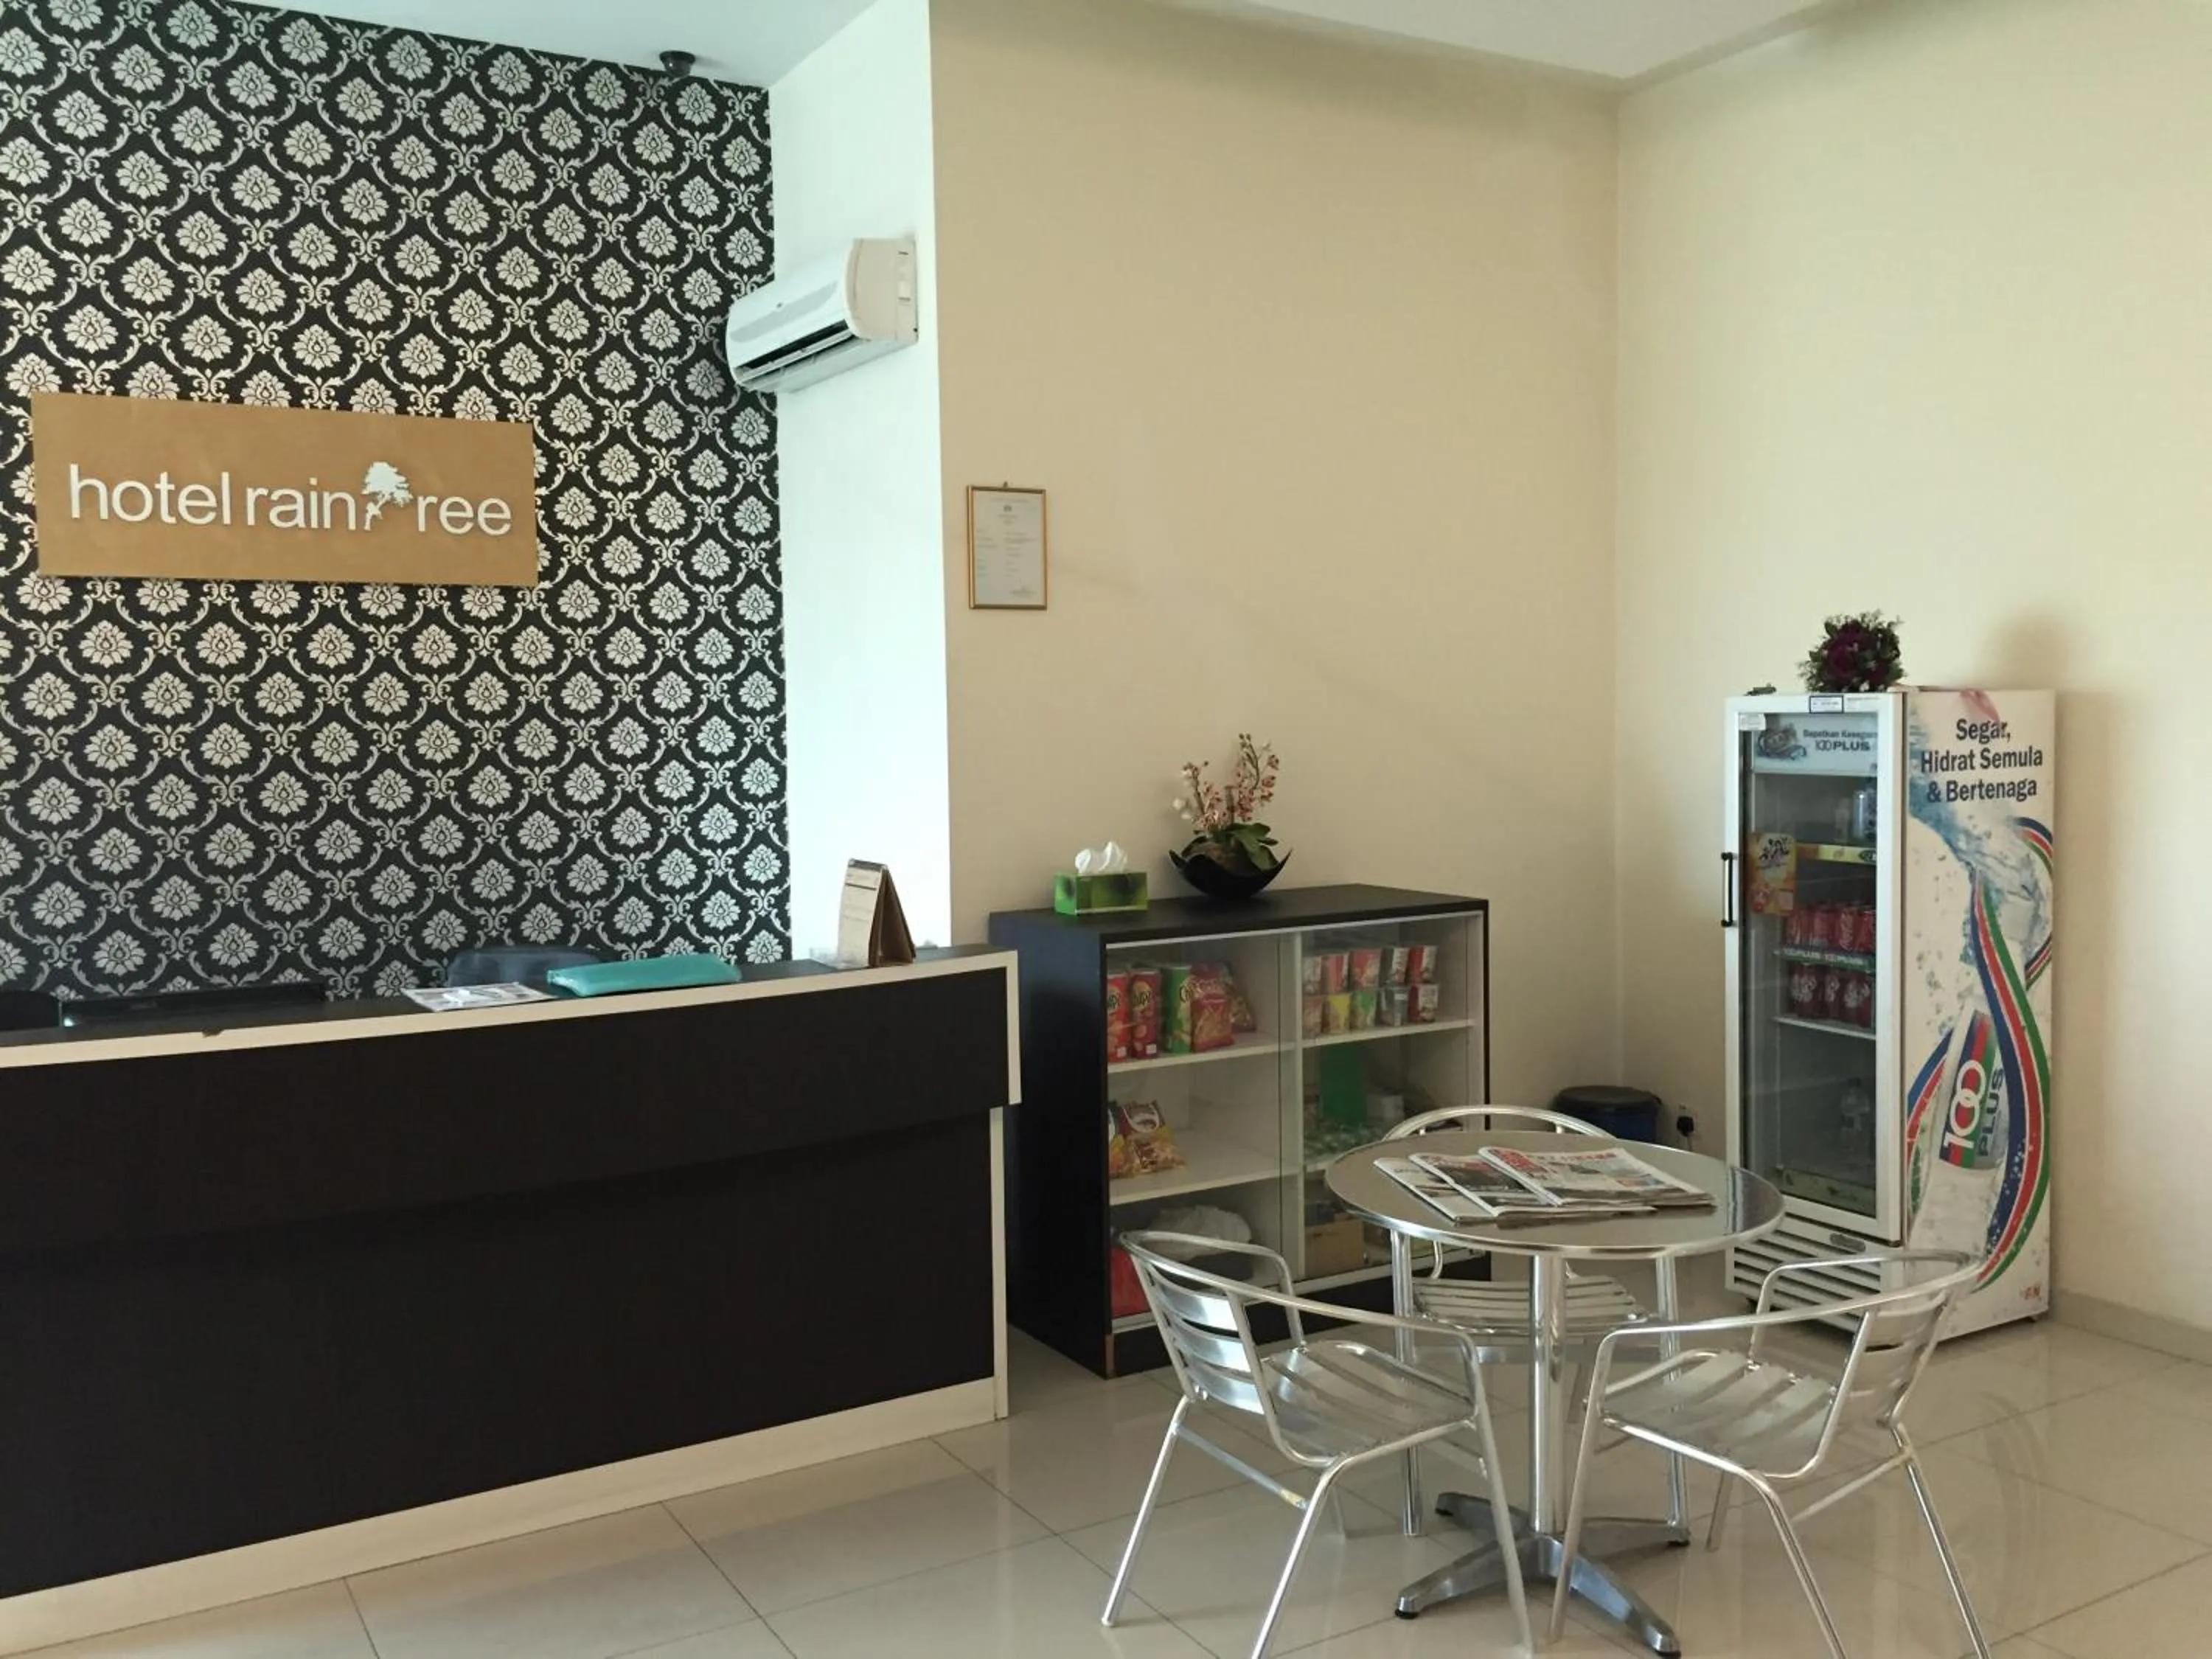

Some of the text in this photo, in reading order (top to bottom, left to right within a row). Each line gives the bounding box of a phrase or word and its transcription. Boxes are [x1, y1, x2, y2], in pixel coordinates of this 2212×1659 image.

[69, 463, 231, 524] hotel
[1955, 718, 2011, 744] Segar,
[1920, 745, 2043, 773] Hidrat Semula
[1927, 778, 2037, 802] & Bertenaga
[1979, 1068, 2003, 1156] PLUS
